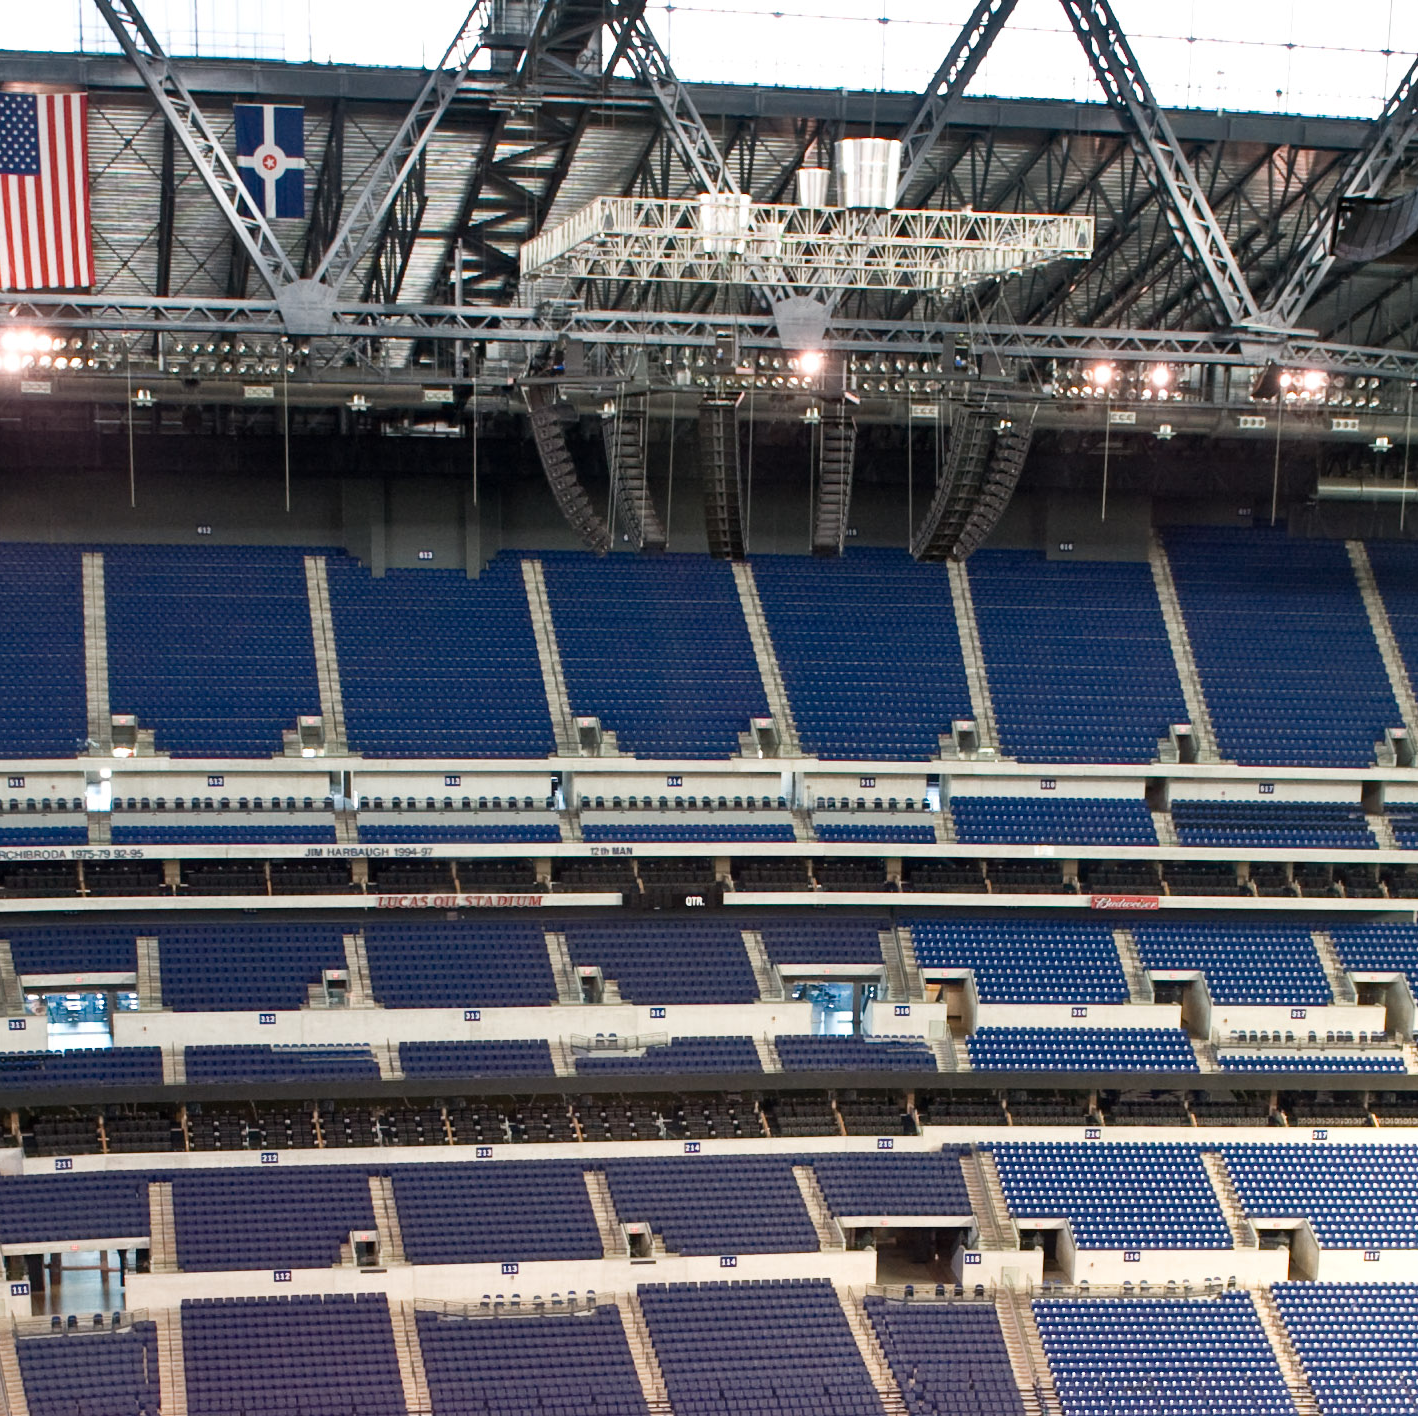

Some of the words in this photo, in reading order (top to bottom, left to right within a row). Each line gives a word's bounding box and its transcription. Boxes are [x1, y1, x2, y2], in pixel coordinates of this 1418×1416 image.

[197, 526, 211, 534] 612
[419, 551, 433, 559] 613
[8, 778, 25, 788] 511
[667, 777, 683, 786] 514
[860, 778, 876, 787] 515
[1259, 784, 1275, 793] 517
[71, 848, 110, 860] 1975-79
[114, 848, 144, 859] 92-95
[304, 846, 324, 857] JIM
[327, 846, 390, 857] HARBAUGH
[393, 846, 433, 857] 1994-97
[611, 845, 633, 856] MAN
[377, 894, 429, 909] LUCAS
[433, 894, 460, 908] OIL
[464, 894, 544, 908] STADIUM
[685, 896, 706, 907] QTR.
[1094, 896, 1158, 910] Budweiser
[650, 1009, 665, 1017] 314
[894, 1007, 910, 1015] 315
[1072, 1008, 1087, 1016] 316
[1291, 1010, 1306, 1018] 317
[260, 1015, 276, 1023] 312
[465, 1012, 480, 1020] 313
[9, 1021, 25, 1029] 311
[1085, 1130, 1101, 1138] 216
[1312, 1131, 1327, 1139] 217
[685, 1144, 700, 1152] 214
[878, 1140, 893, 1148] 215
[476, 1149, 492, 1157] 213
[261, 1154, 278, 1162] 212
[55, 1160, 72, 1169] 211
[965, 1255, 980, 1263] 115
[1125, 1252, 1140, 1261] 116
[1364, 1252, 1380, 1260] 117
[721, 1258, 736, 1266] 114
[503, 1265, 518, 1273] 113
[275, 1272, 291, 1281] 112
[12, 1285, 28, 1295] 111
